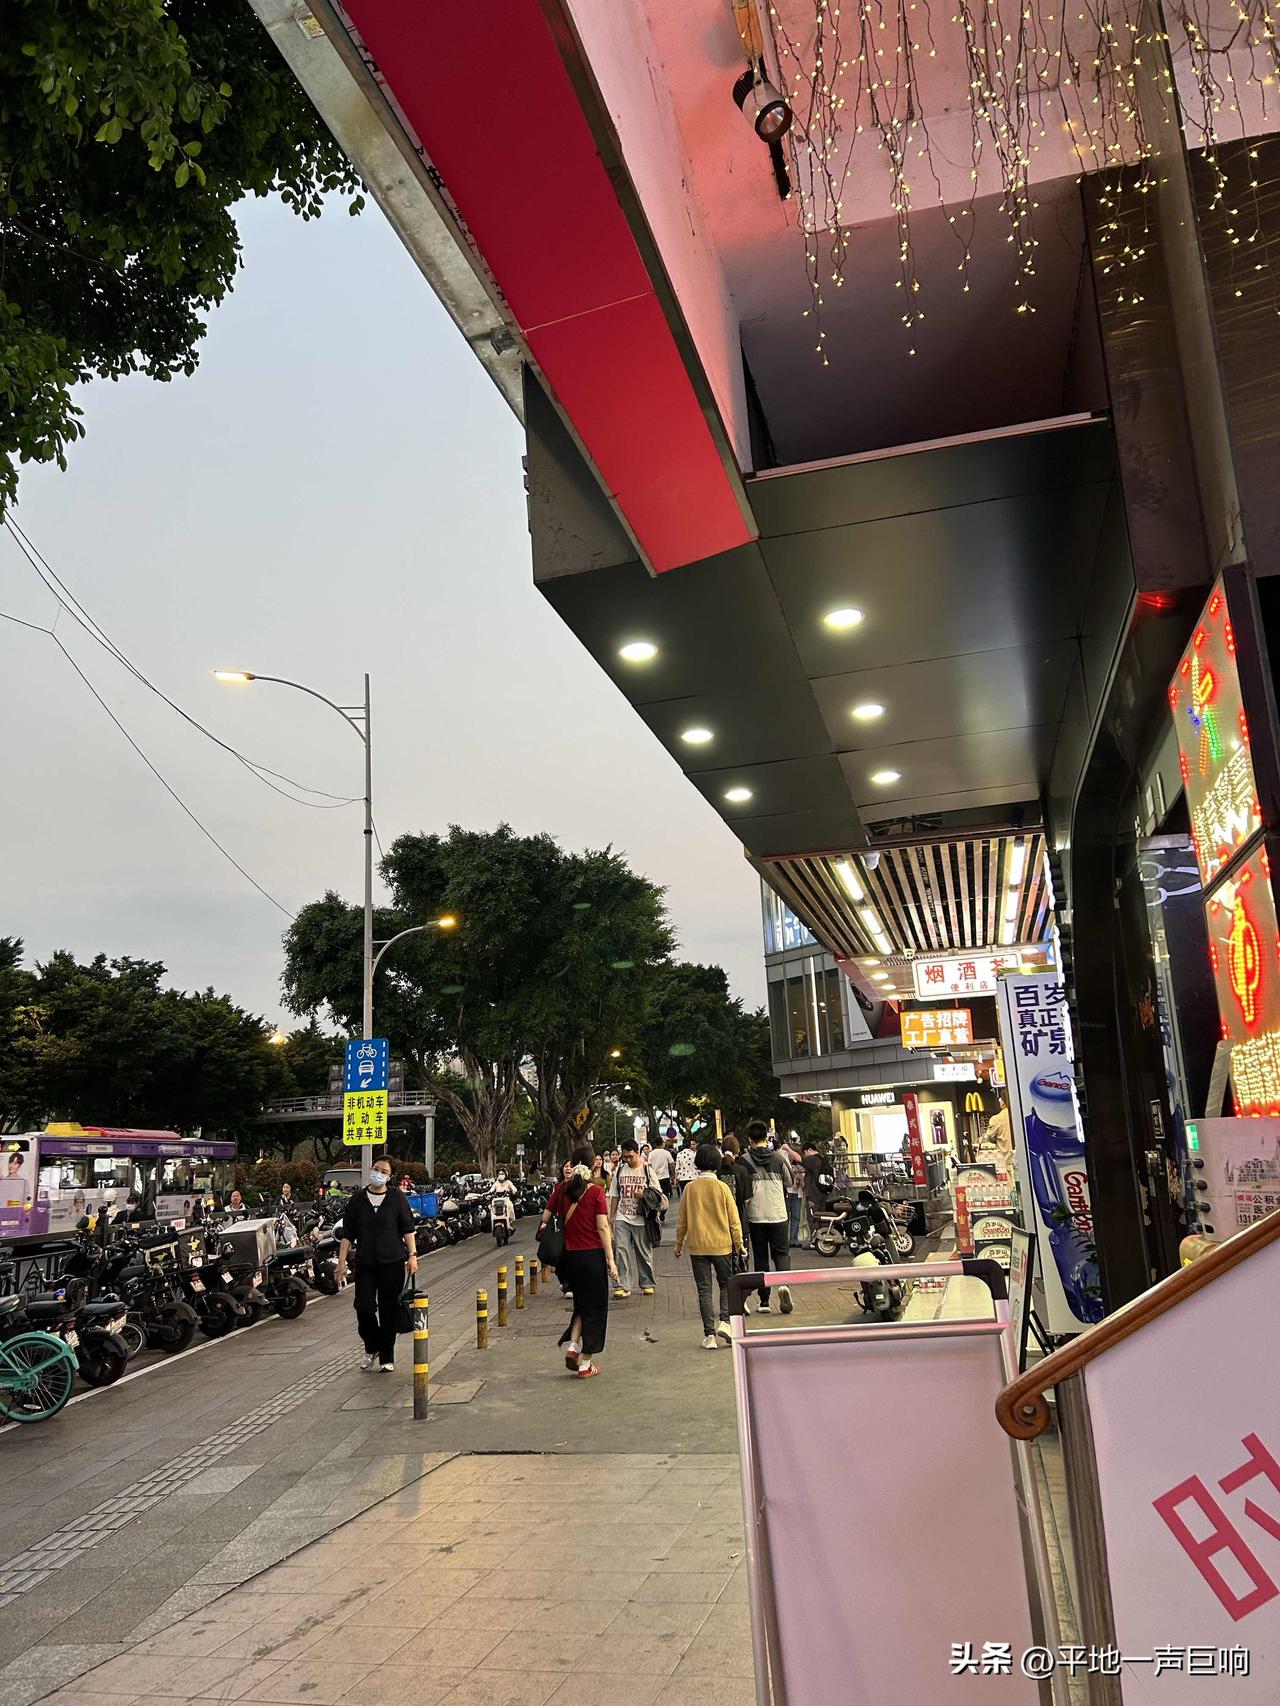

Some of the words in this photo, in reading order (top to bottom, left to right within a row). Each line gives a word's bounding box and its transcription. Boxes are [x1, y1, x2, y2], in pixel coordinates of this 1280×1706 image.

[925, 958, 1007, 984] 烟酒茶
[950, 981, 989, 992] 便利店
[905, 1012, 968, 1029] 广告招牌
[1017, 1007, 1066, 1029] 真正
[348, 1095, 384, 1109] 非机动车
[861, 1093, 895, 1105] HUAWEI
[347, 1111, 384, 1125] 机动车
[346, 1126, 383, 1140] 共享车道
